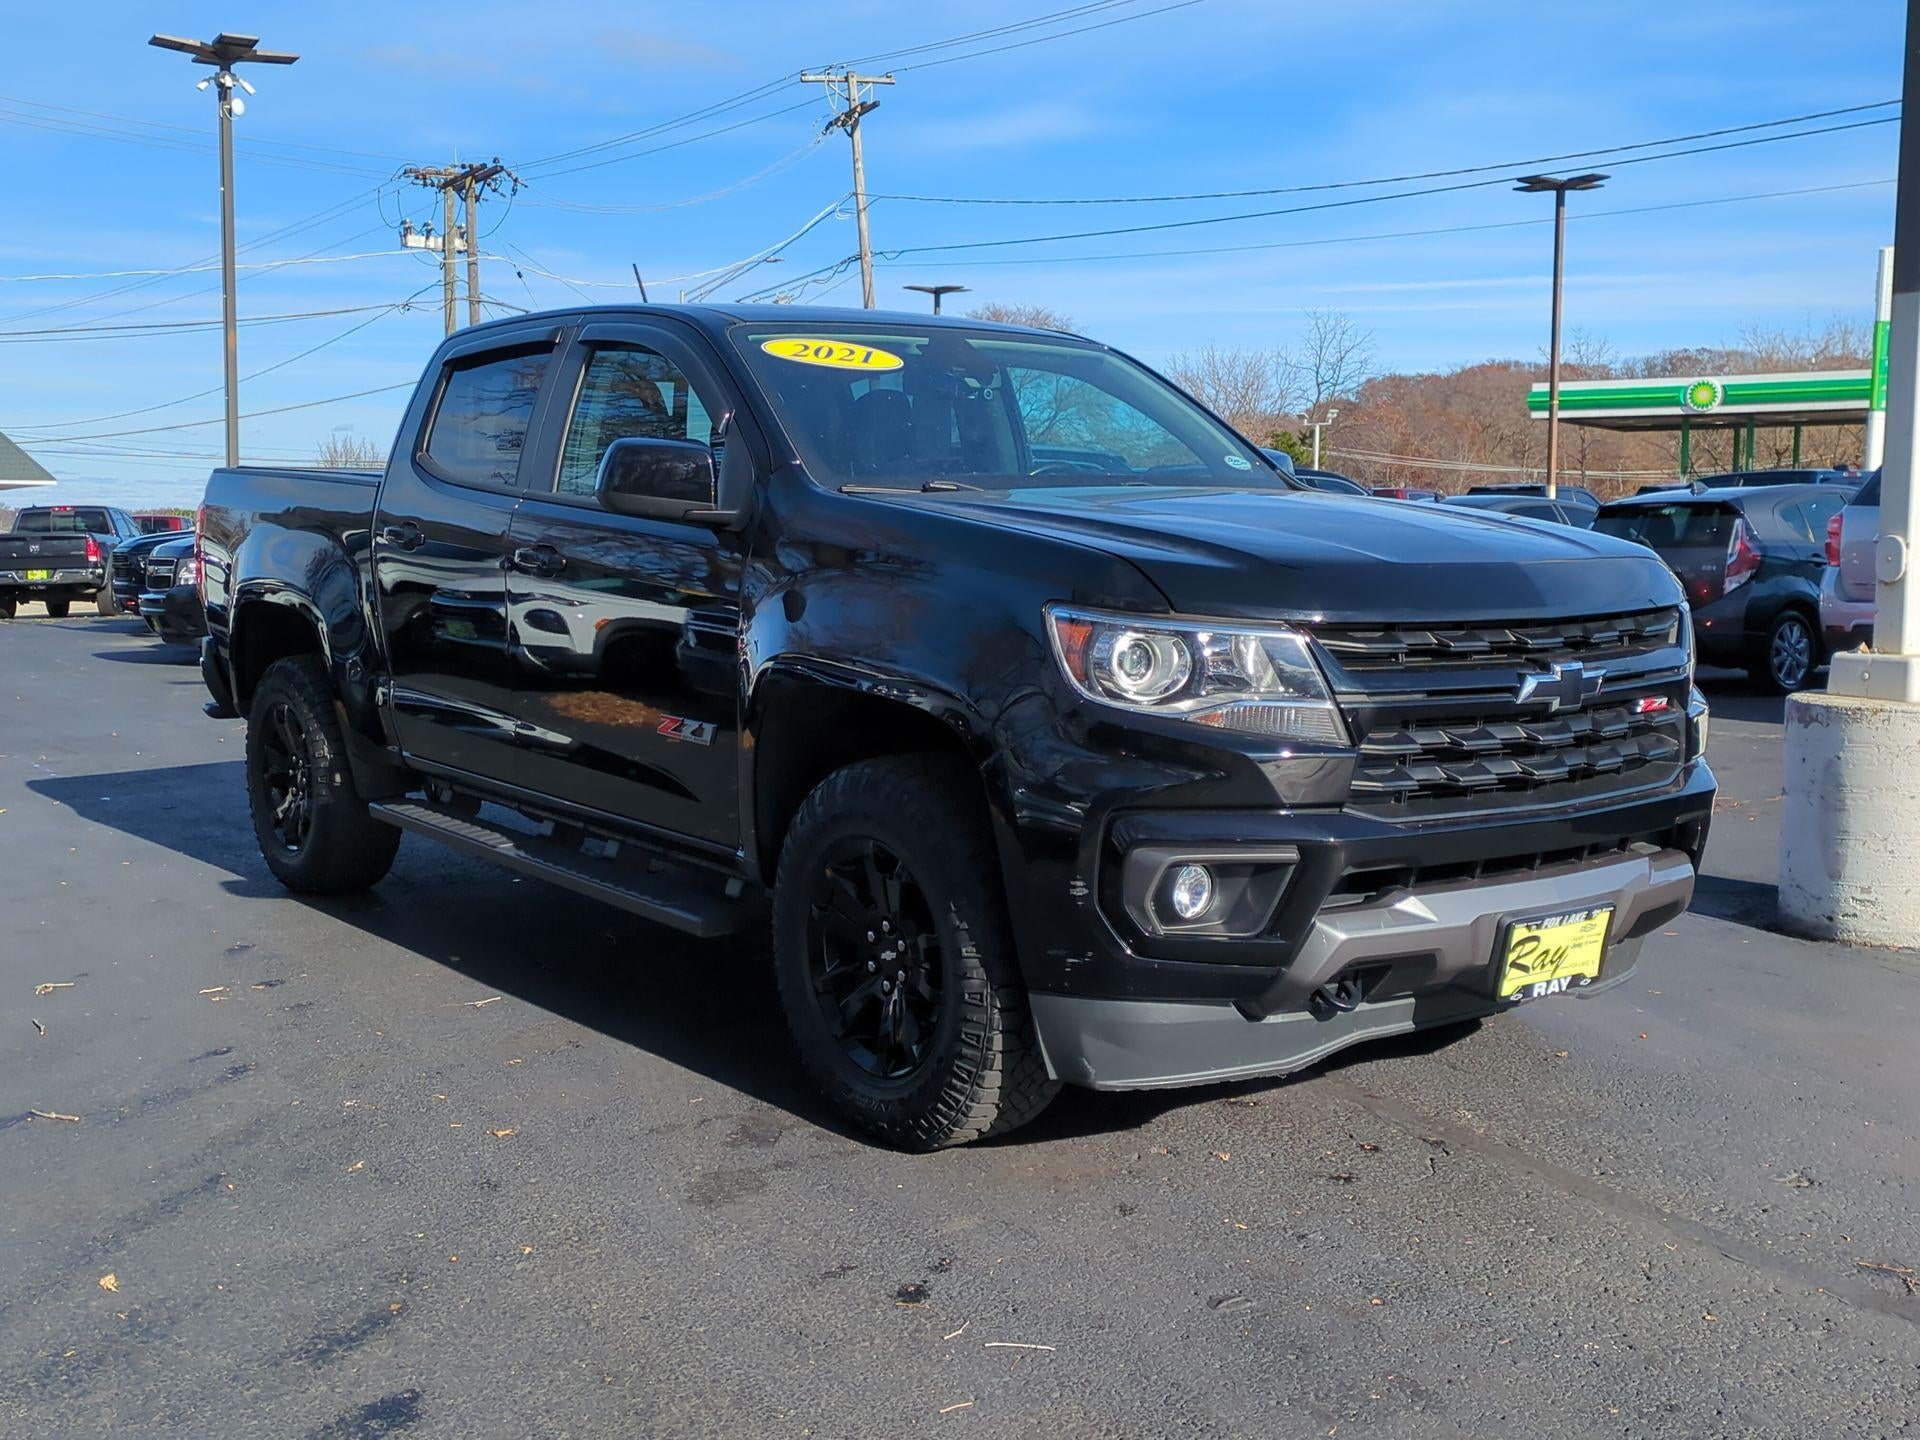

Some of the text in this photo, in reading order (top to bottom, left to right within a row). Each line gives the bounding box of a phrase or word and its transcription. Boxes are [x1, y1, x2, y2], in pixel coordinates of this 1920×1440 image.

[791, 343, 875, 364] 2021
[656, 713, 718, 746] Z71
[1541, 915, 1563, 929] FOX
[1563, 911, 1589, 925] LAKE
[1506, 935, 1570, 978] Ray
[1532, 976, 1573, 998] RAY
